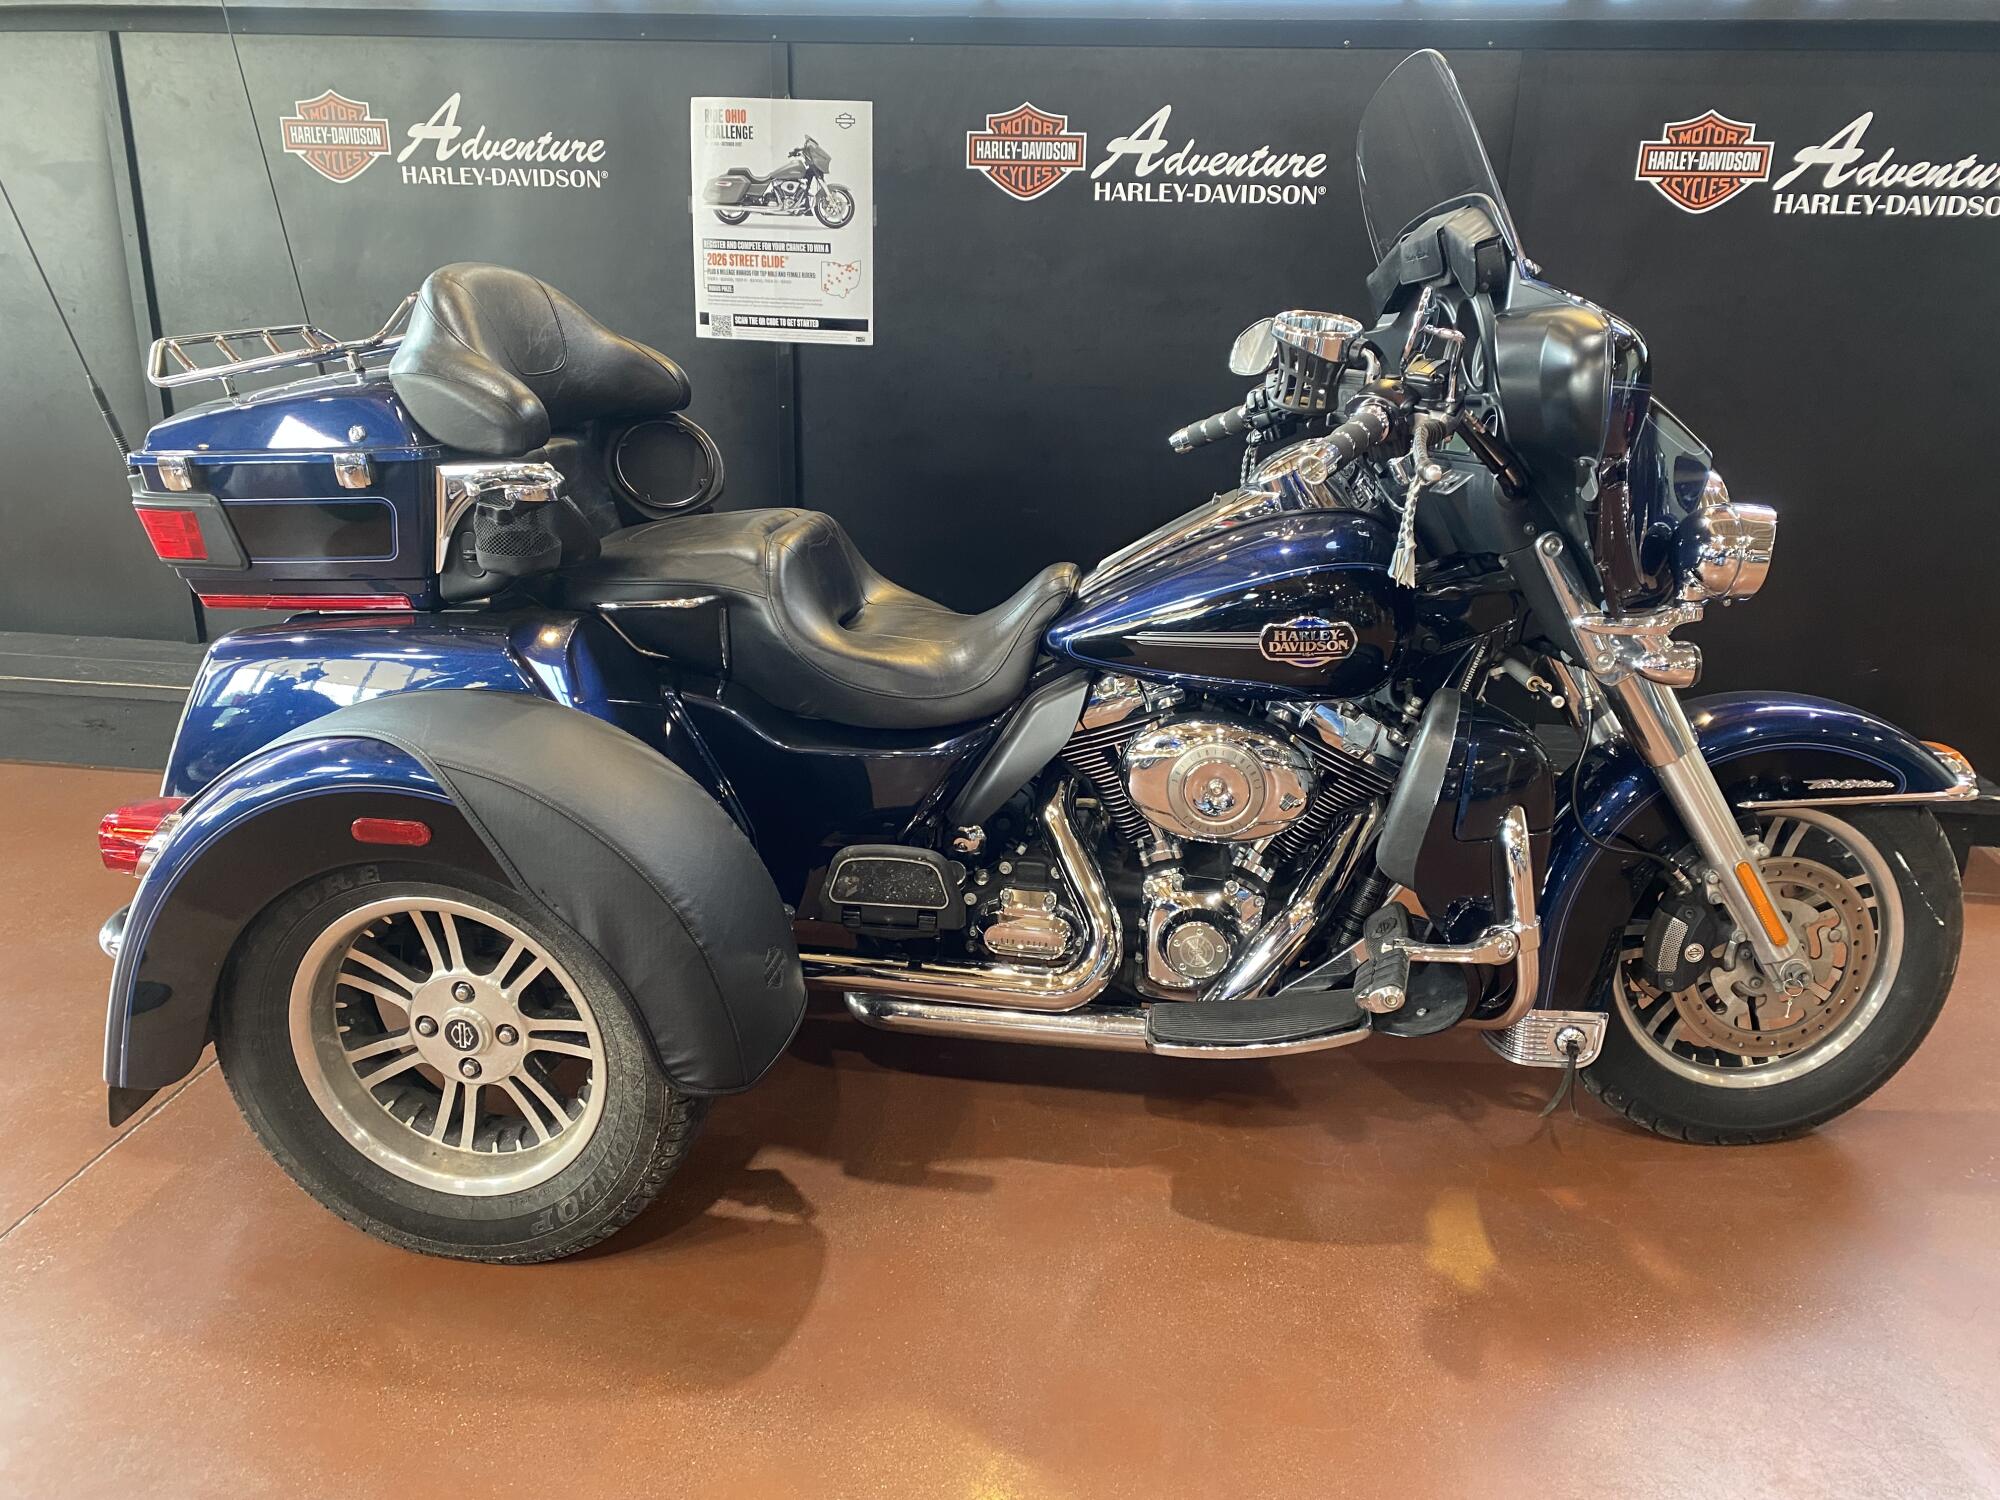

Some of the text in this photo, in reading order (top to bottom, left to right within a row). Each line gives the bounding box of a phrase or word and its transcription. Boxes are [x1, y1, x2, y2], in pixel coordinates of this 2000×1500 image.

[309, 101, 358, 121] MOTOR
[725, 108, 747, 124] OHIO
[396, 92, 606, 163] Adventure
[1000, 114, 1053, 135] MOTOR
[1678, 122, 1738, 145] MOTOR
[289, 125, 382, 146] HARLEY-DAVIDSON
[1090, 104, 1328, 180] Adventure
[976, 140, 1077, 161] HARLEY-DAVIDSON
[1647, 150, 1762, 172] HARLEY-DAVIDSON
[1772, 111, 2000, 190] Adventu
[313, 149, 363, 174] CYCLES
[999, 165, 1052, 191] CYCLES
[1671, 176, 1731, 203] CYCLES
[707, 252, 727, 266] 2026
[729, 253, 760, 267] STREET
[1268, 639, 1350, 653] DAVIDSON
[1273, 629, 1345, 642] HARLEY-
